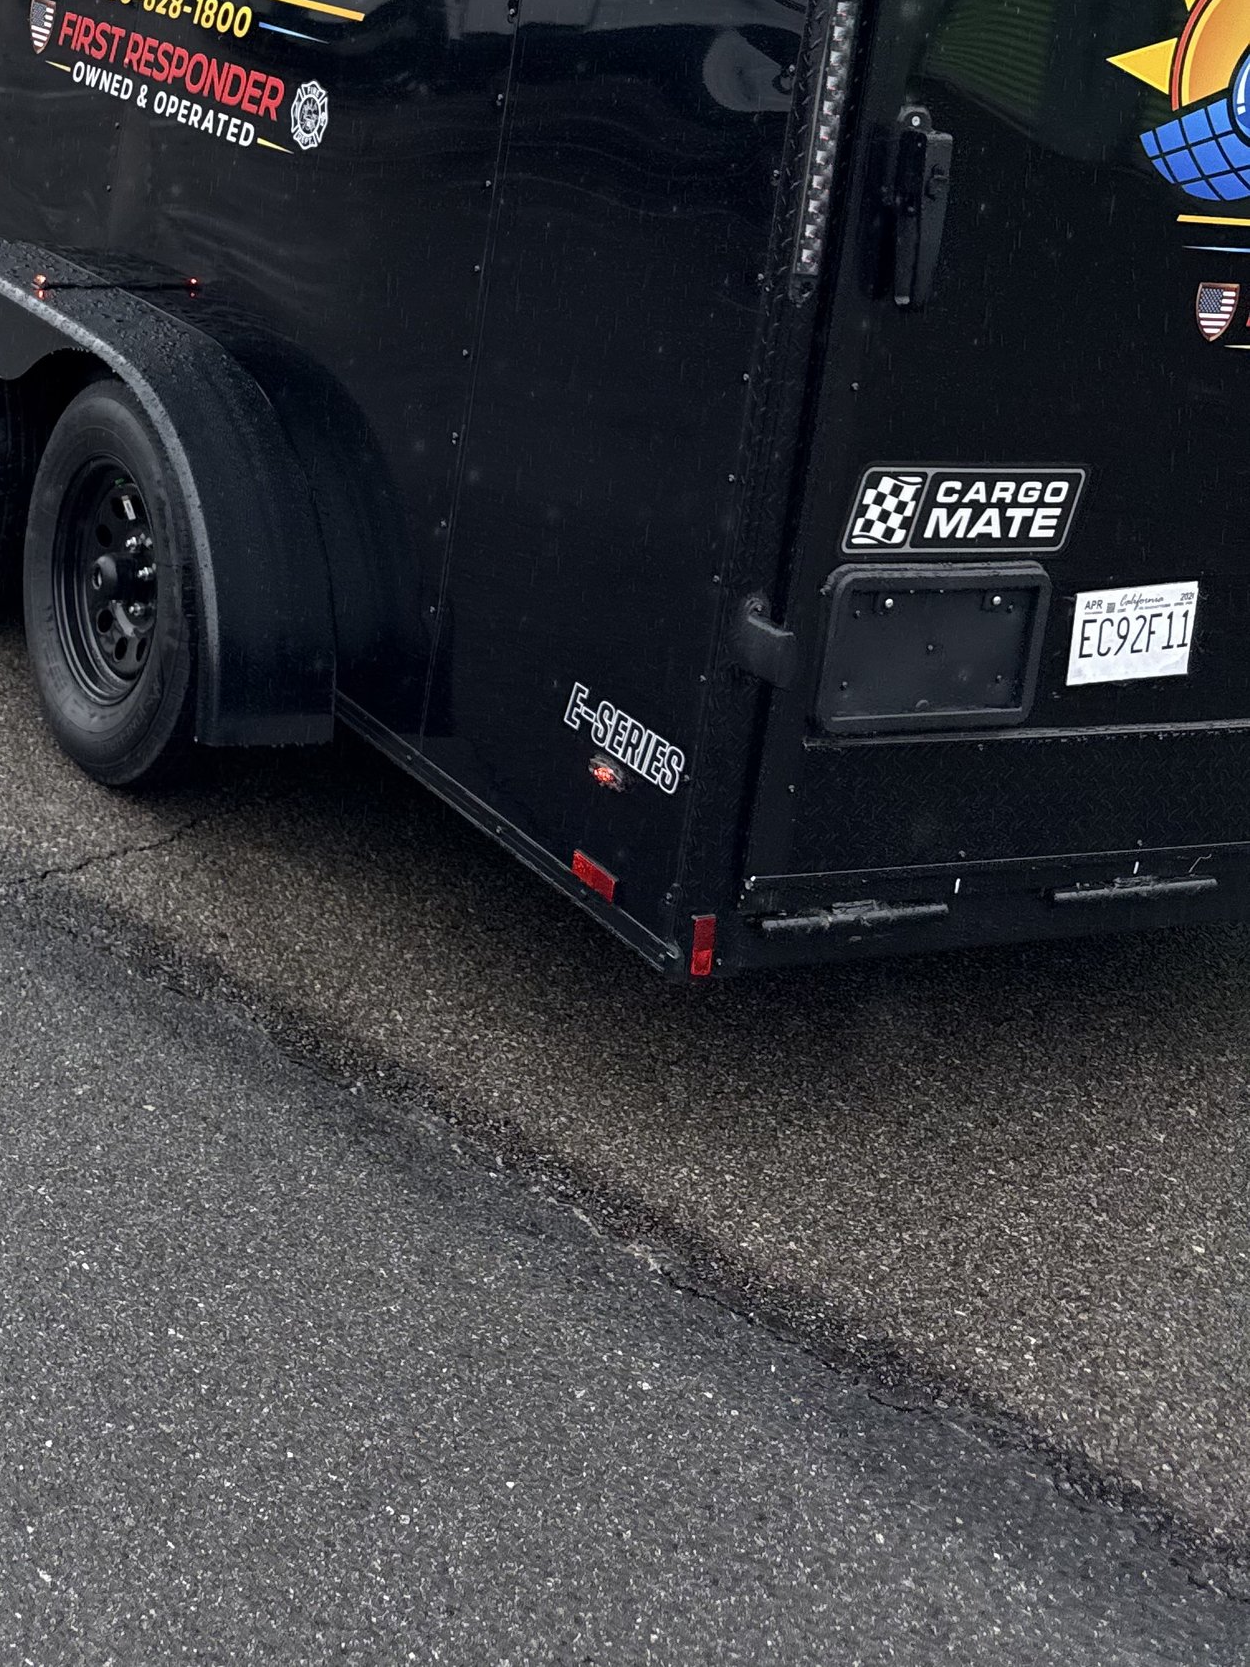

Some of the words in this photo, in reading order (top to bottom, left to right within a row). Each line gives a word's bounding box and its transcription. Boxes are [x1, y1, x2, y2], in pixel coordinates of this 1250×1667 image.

[58, 11, 126, 63] FIRST
[123, 32, 285, 121] RESPONDER
[72, 61, 133, 100] OWNED
[136, 85, 148, 108] &
[153, 91, 255, 147] OPERATED
[936, 481, 1069, 503] CARGO
[923, 508, 1062, 538] MATE
[1084, 599, 1103, 610] APR
[1120, 593, 1164, 611] California
[1078, 609, 1189, 658] EC92F11
[563, 681, 685, 795] E-SERIES
